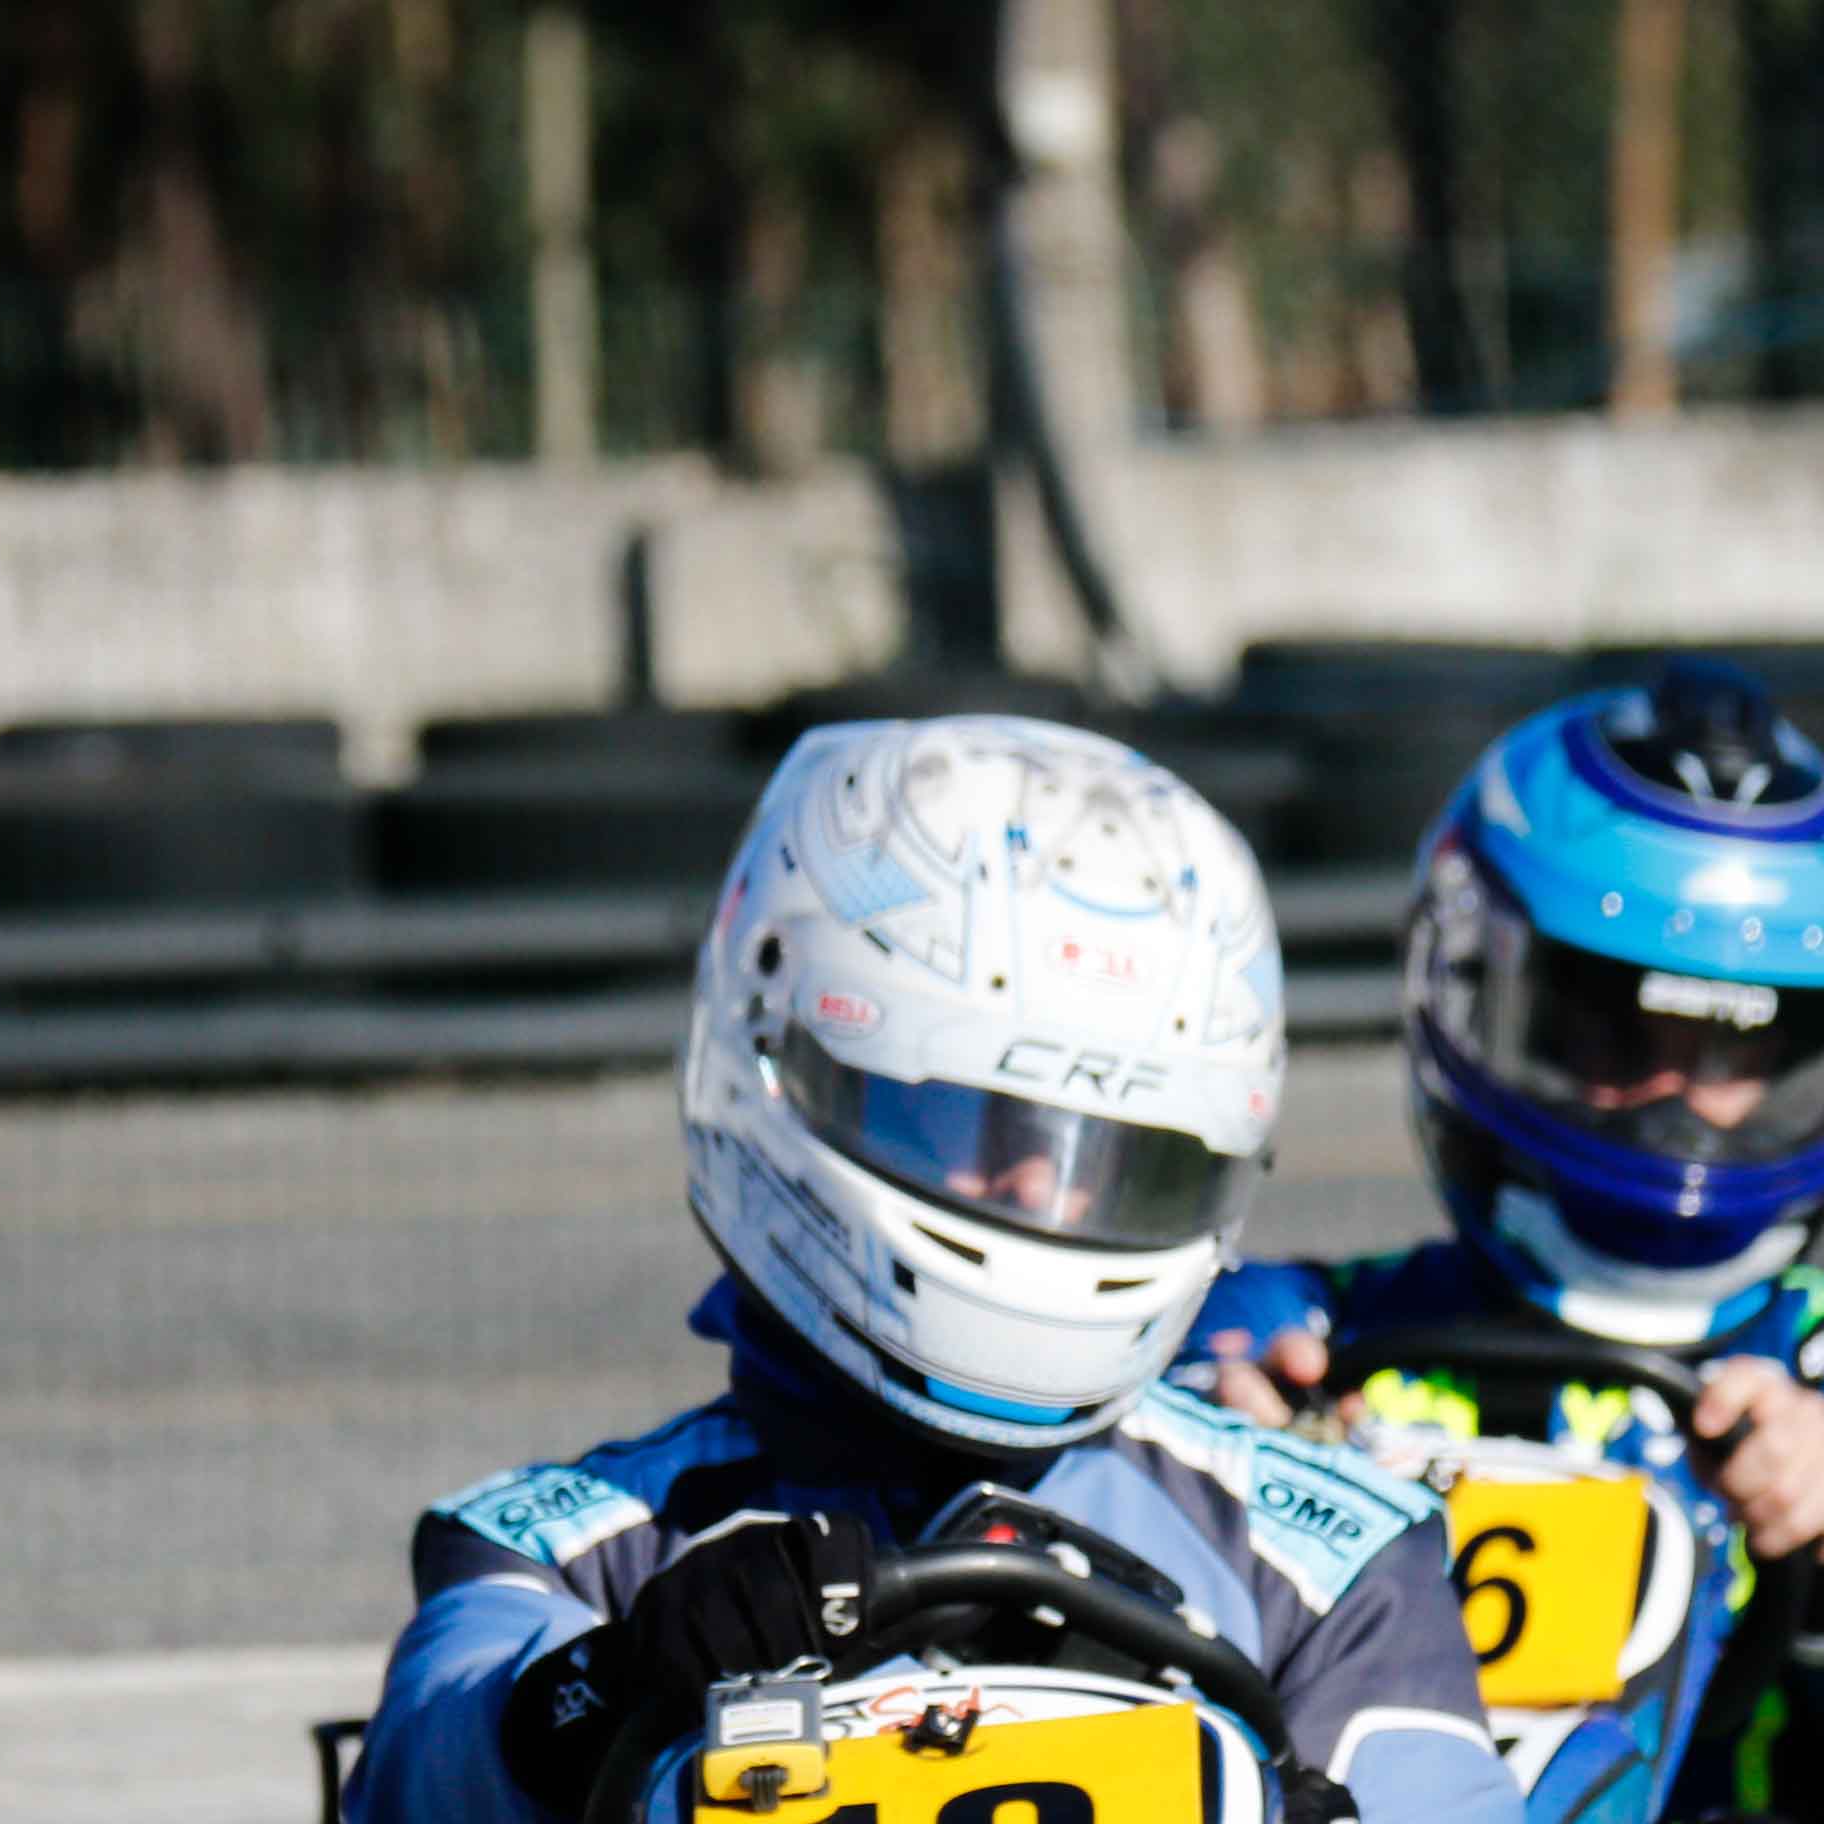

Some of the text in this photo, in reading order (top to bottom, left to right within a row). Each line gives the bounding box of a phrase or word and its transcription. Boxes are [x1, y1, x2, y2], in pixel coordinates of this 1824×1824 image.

[995, 1038, 1171, 1101] CRF
[1259, 1481, 1363, 1543] OMP
[1450, 1525, 1536, 1666] 6
